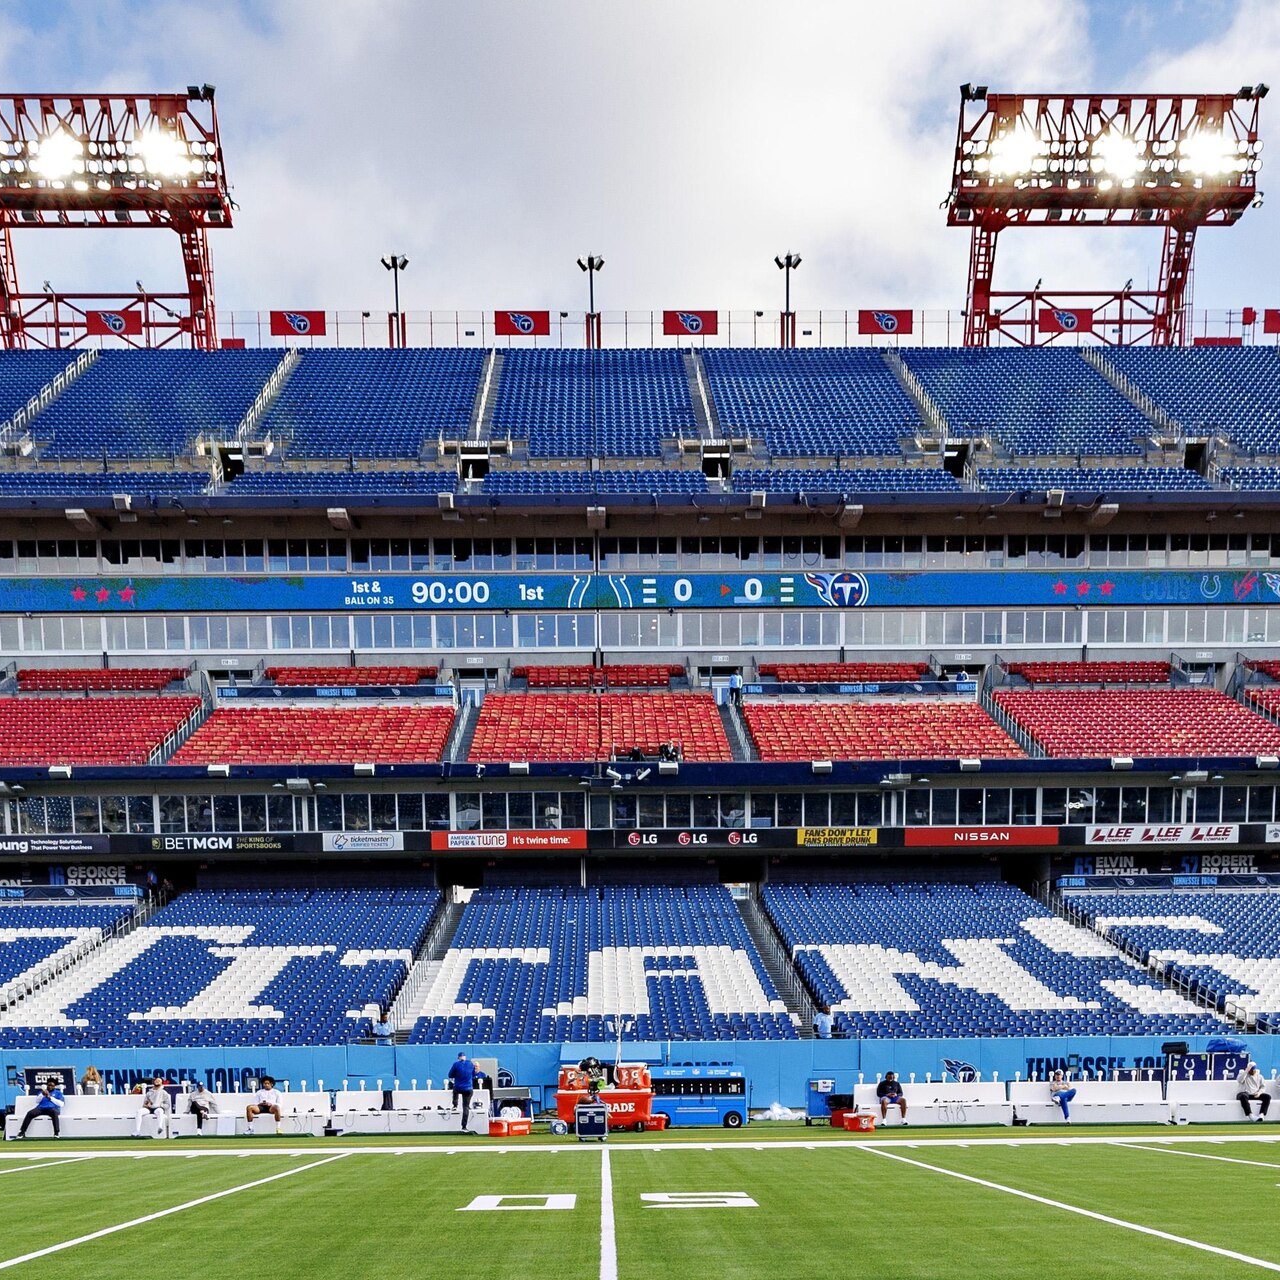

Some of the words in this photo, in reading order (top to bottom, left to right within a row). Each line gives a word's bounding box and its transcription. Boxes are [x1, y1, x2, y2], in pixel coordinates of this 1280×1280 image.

[352, 581, 369, 593] 1st
[371, 581, 381, 593] &
[519, 584, 543, 600] 1st
[674, 578, 692, 601] 0
[744, 577, 763, 601] 0
[411, 582, 489, 603] 90:00
[805, 829, 827, 837] FANS
[828, 829, 855, 837] DON'T
[856, 829, 871, 837] LET
[1108, 828, 1134, 837] LEE
[1157, 827, 1183, 837] LEE
[1207, 827, 1233, 836] LEE
[165, 837, 232, 849] BETMGM
[513, 836, 524, 844] It's
[526, 836, 548, 844] twine
[643, 834, 657, 844] LG
[693, 834, 707, 844] LG
[743, 834, 757, 844] LG
[1096, 857, 1134, 867] ELVIN
[1202, 855, 1255, 866] ROBERT
[67, 866, 126, 878] GEORGE
